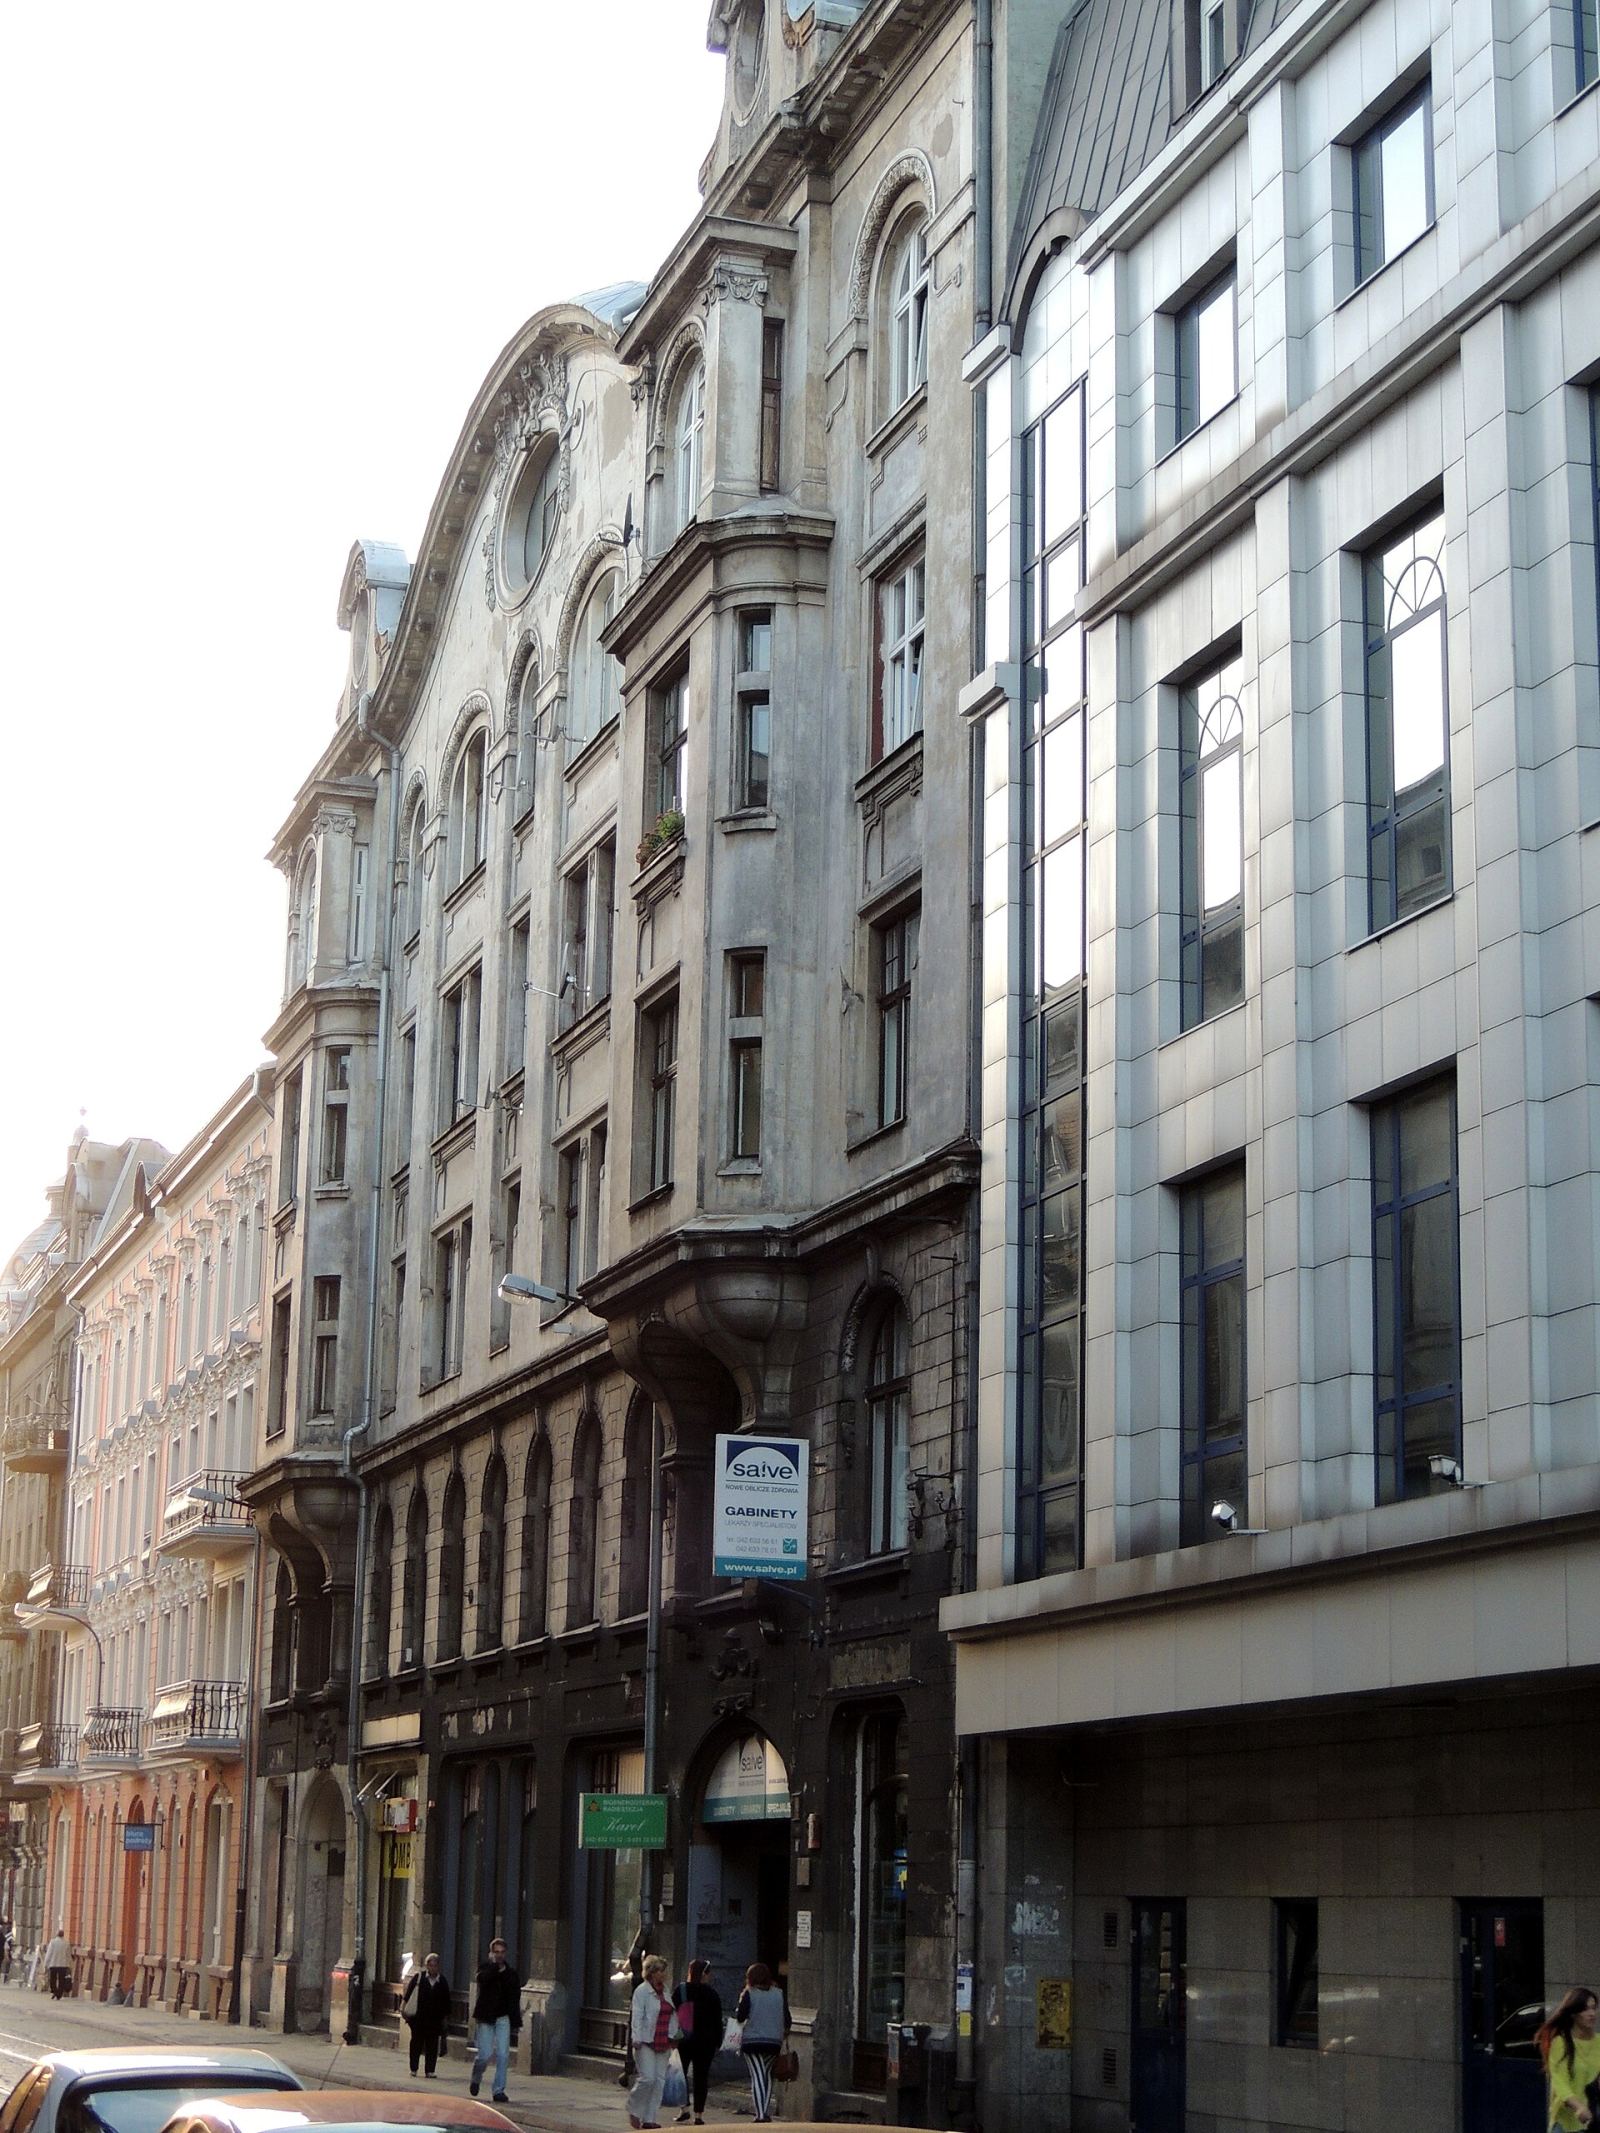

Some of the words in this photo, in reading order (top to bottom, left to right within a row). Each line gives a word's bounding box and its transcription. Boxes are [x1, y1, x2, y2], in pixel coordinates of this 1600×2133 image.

[771, 1486, 799, 1494] ZDROWIA
[725, 1506, 798, 1519] GABINETY
[724, 1563, 797, 1576] www.salve.pl
